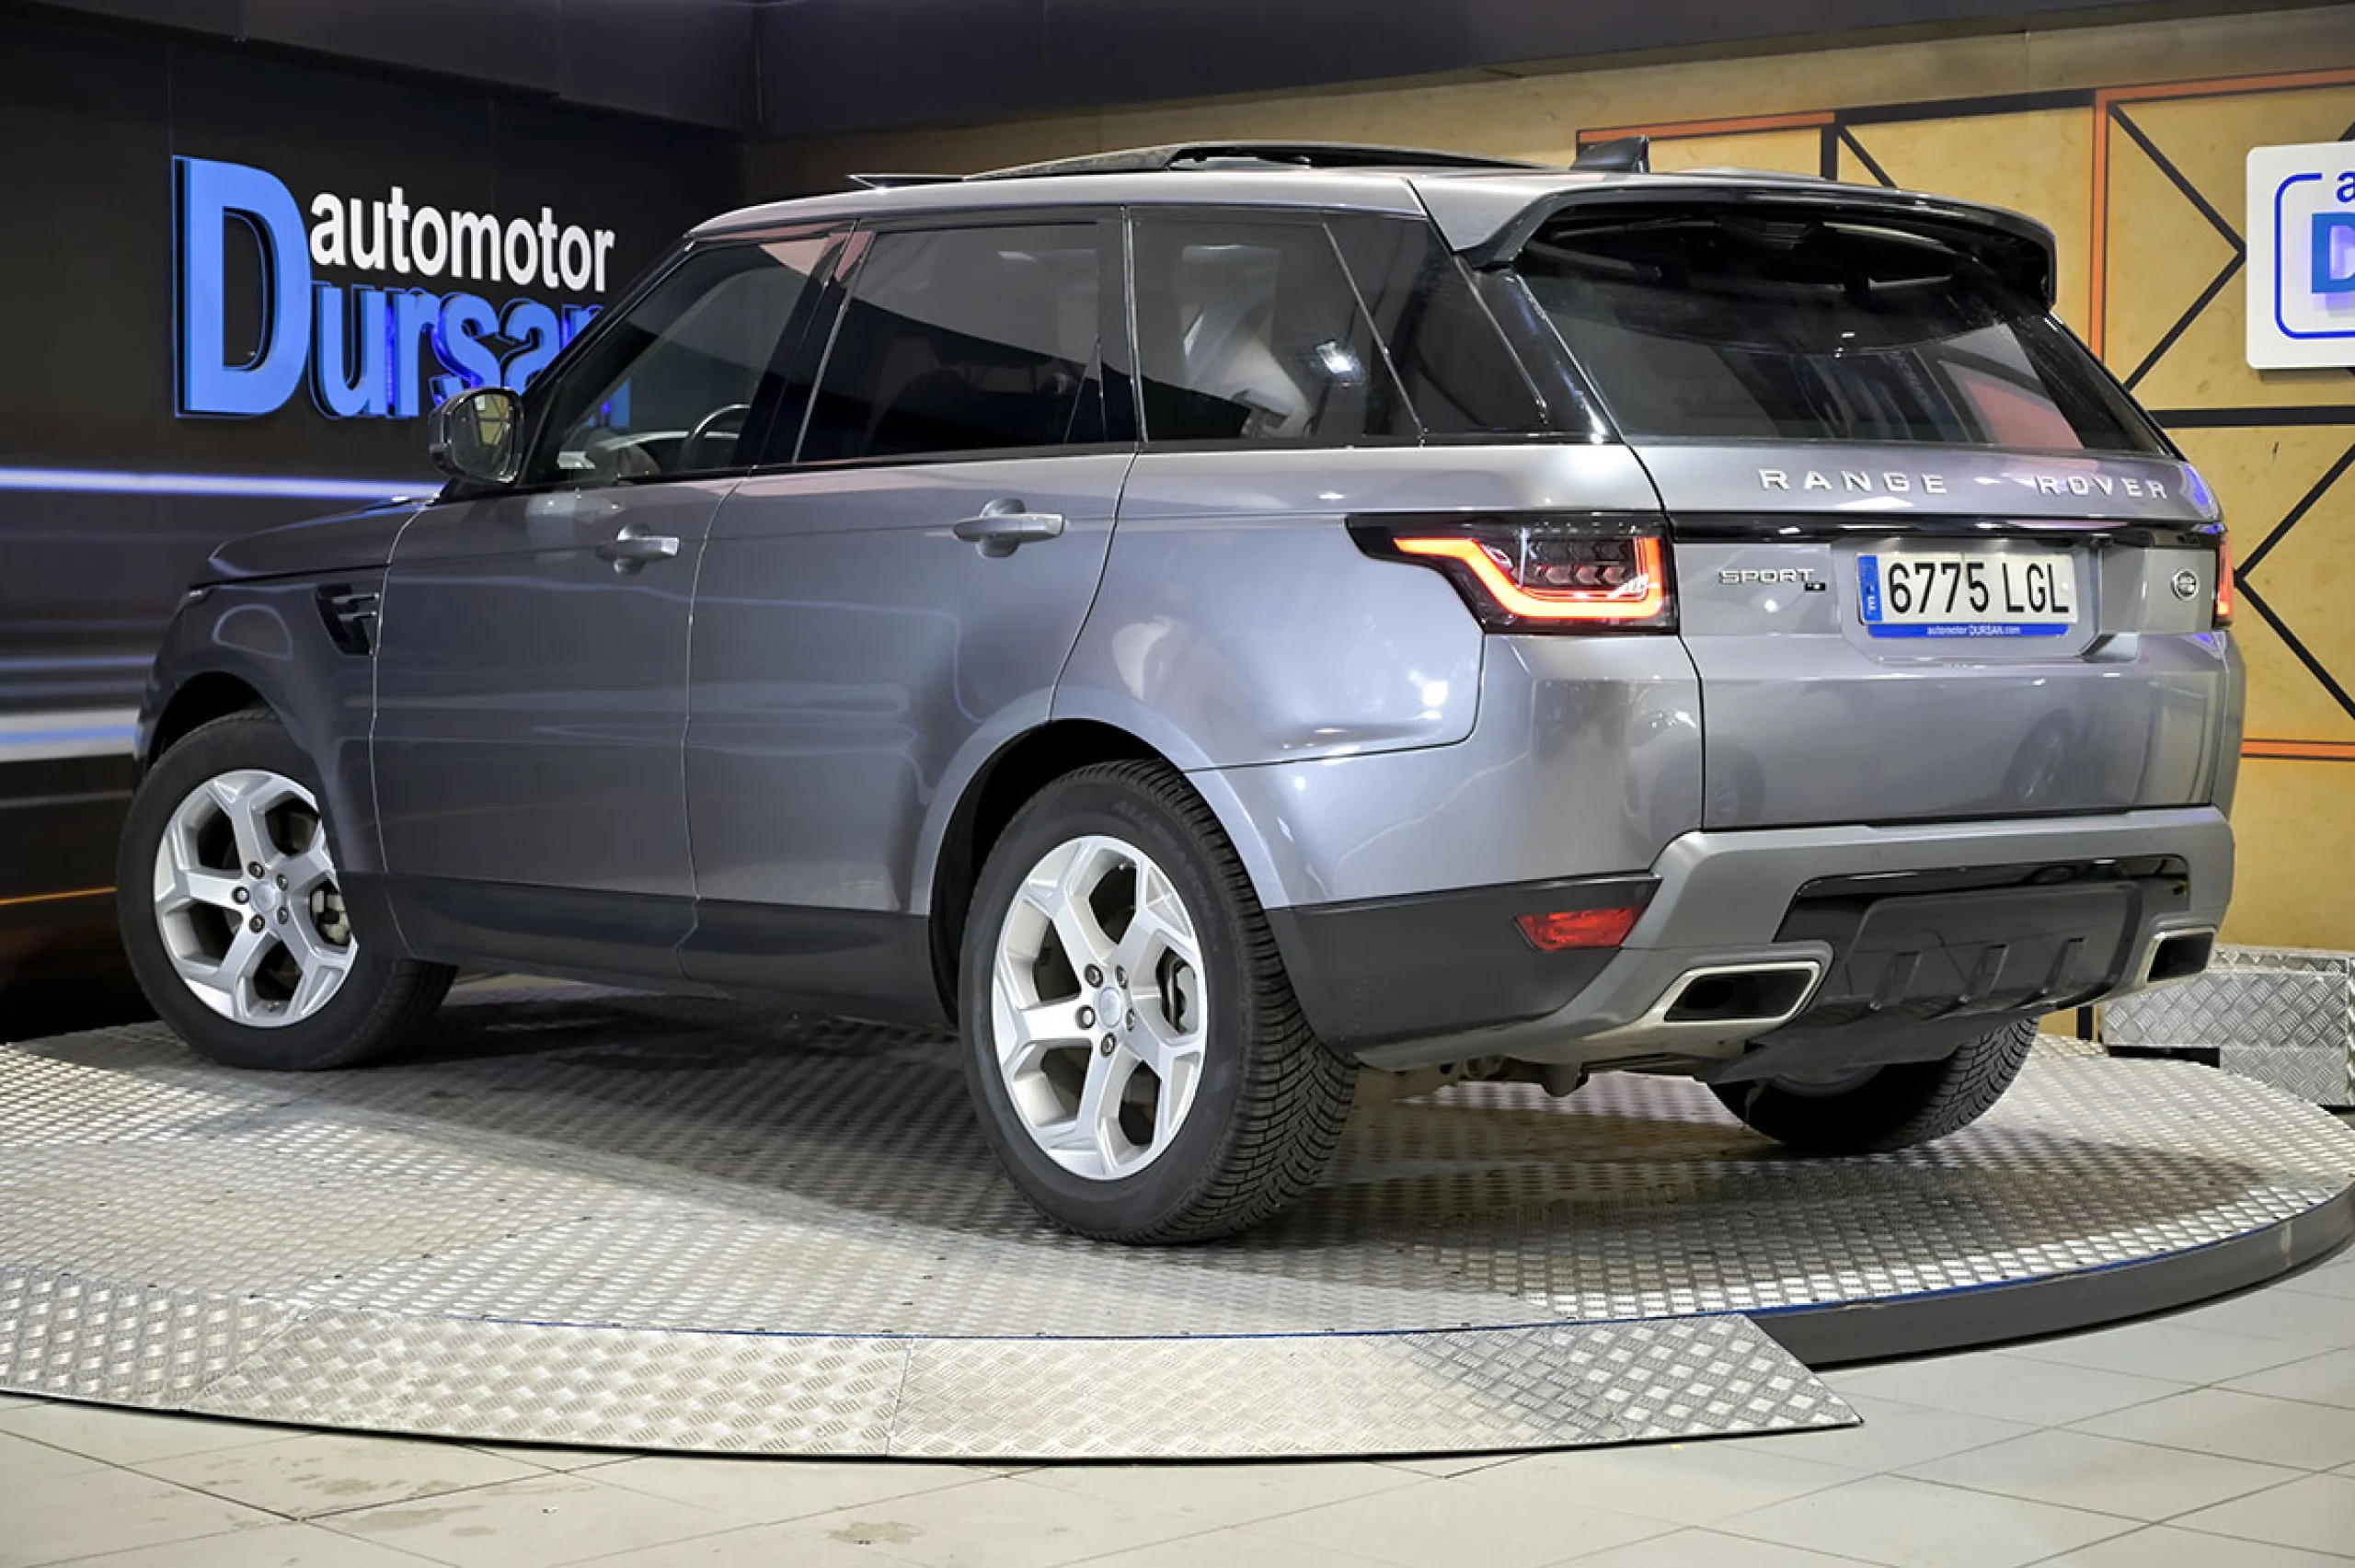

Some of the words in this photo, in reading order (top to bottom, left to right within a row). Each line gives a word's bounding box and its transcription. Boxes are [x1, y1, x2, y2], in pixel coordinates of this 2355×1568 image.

[310, 187, 615, 292] automotor
[1758, 468, 1948, 494] RANGE
[2034, 474, 2167, 499] ROVER
[1718, 568, 1814, 584] SPORT
[1889, 562, 1990, 614] 6775
[2001, 562, 2070, 613] LGL
[1867, 596, 1878, 612] E
